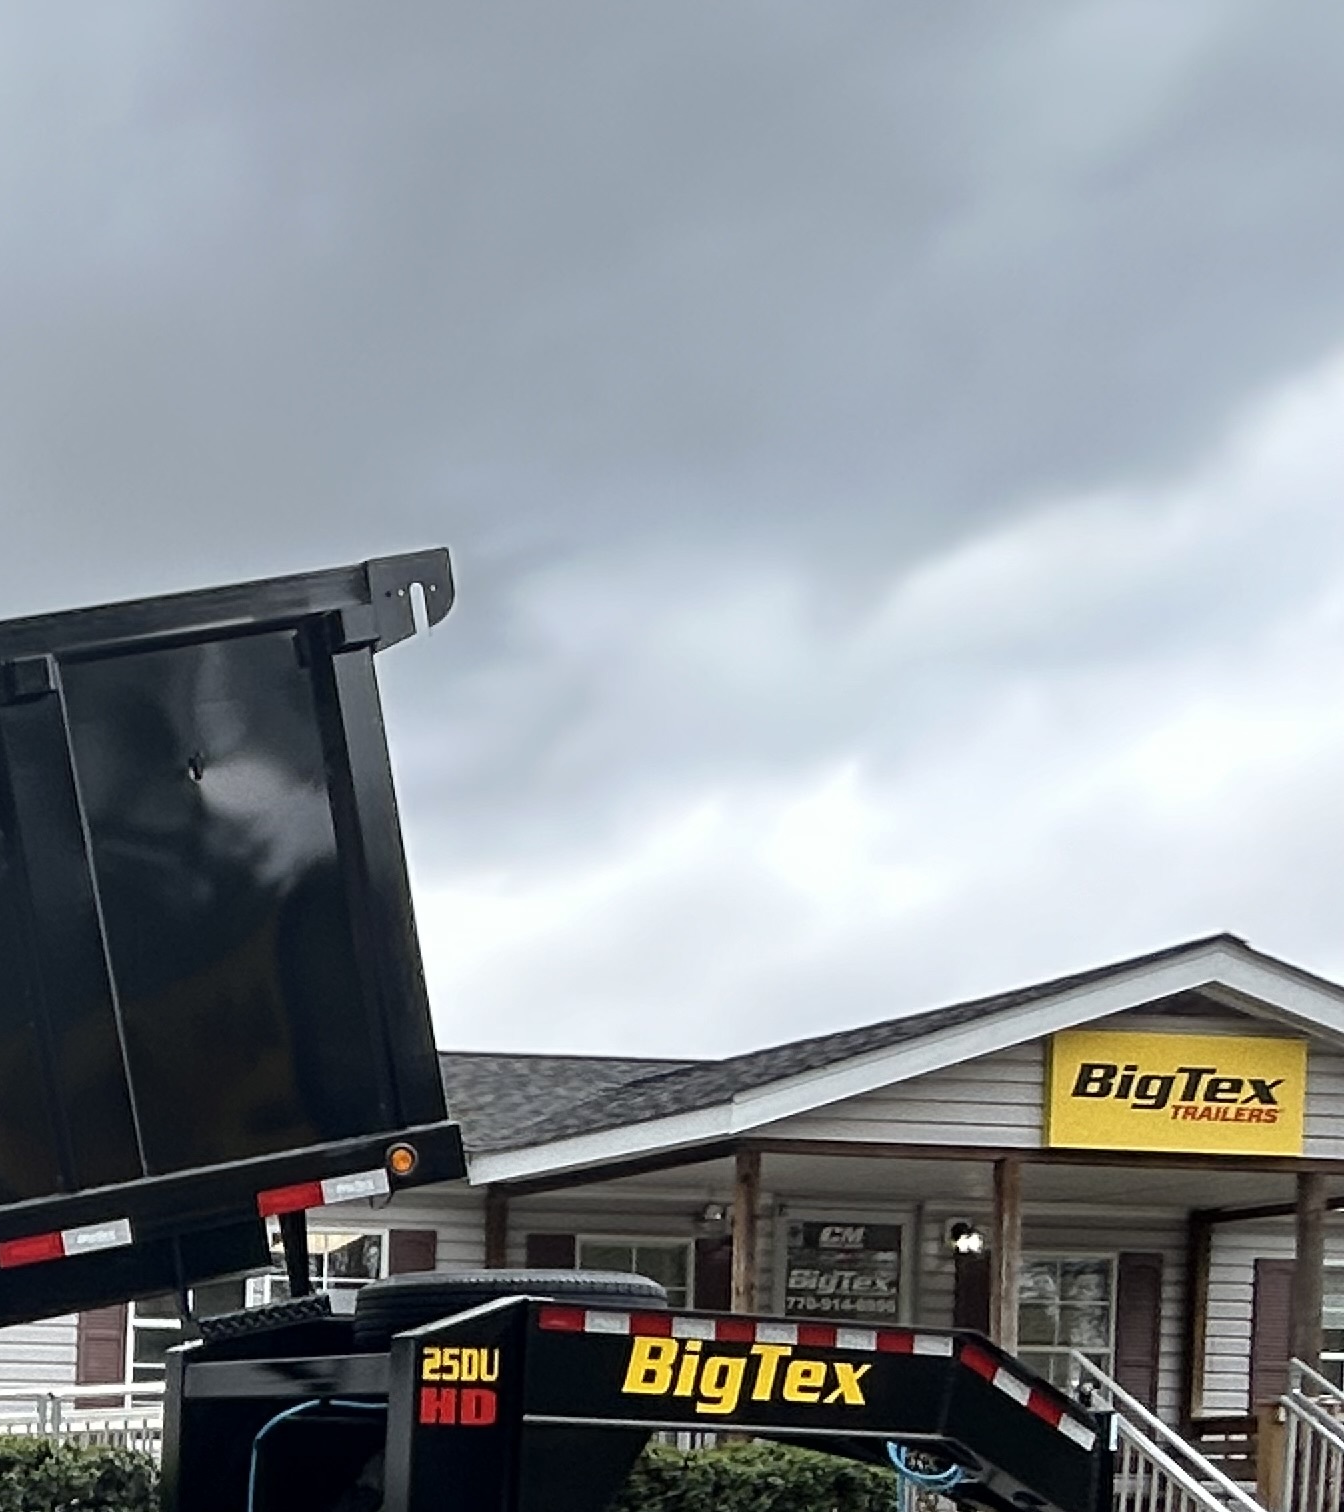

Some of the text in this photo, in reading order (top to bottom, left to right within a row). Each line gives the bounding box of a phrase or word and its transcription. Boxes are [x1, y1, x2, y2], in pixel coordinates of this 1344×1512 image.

[1071, 1063, 1286, 1110] BigTex
[1170, 1105, 1281, 1124] TRAILERS
[422, 1347, 500, 1382] 25DU
[621, 1336, 872, 1414] BigTex
[419, 1386, 497, 1425] HD
